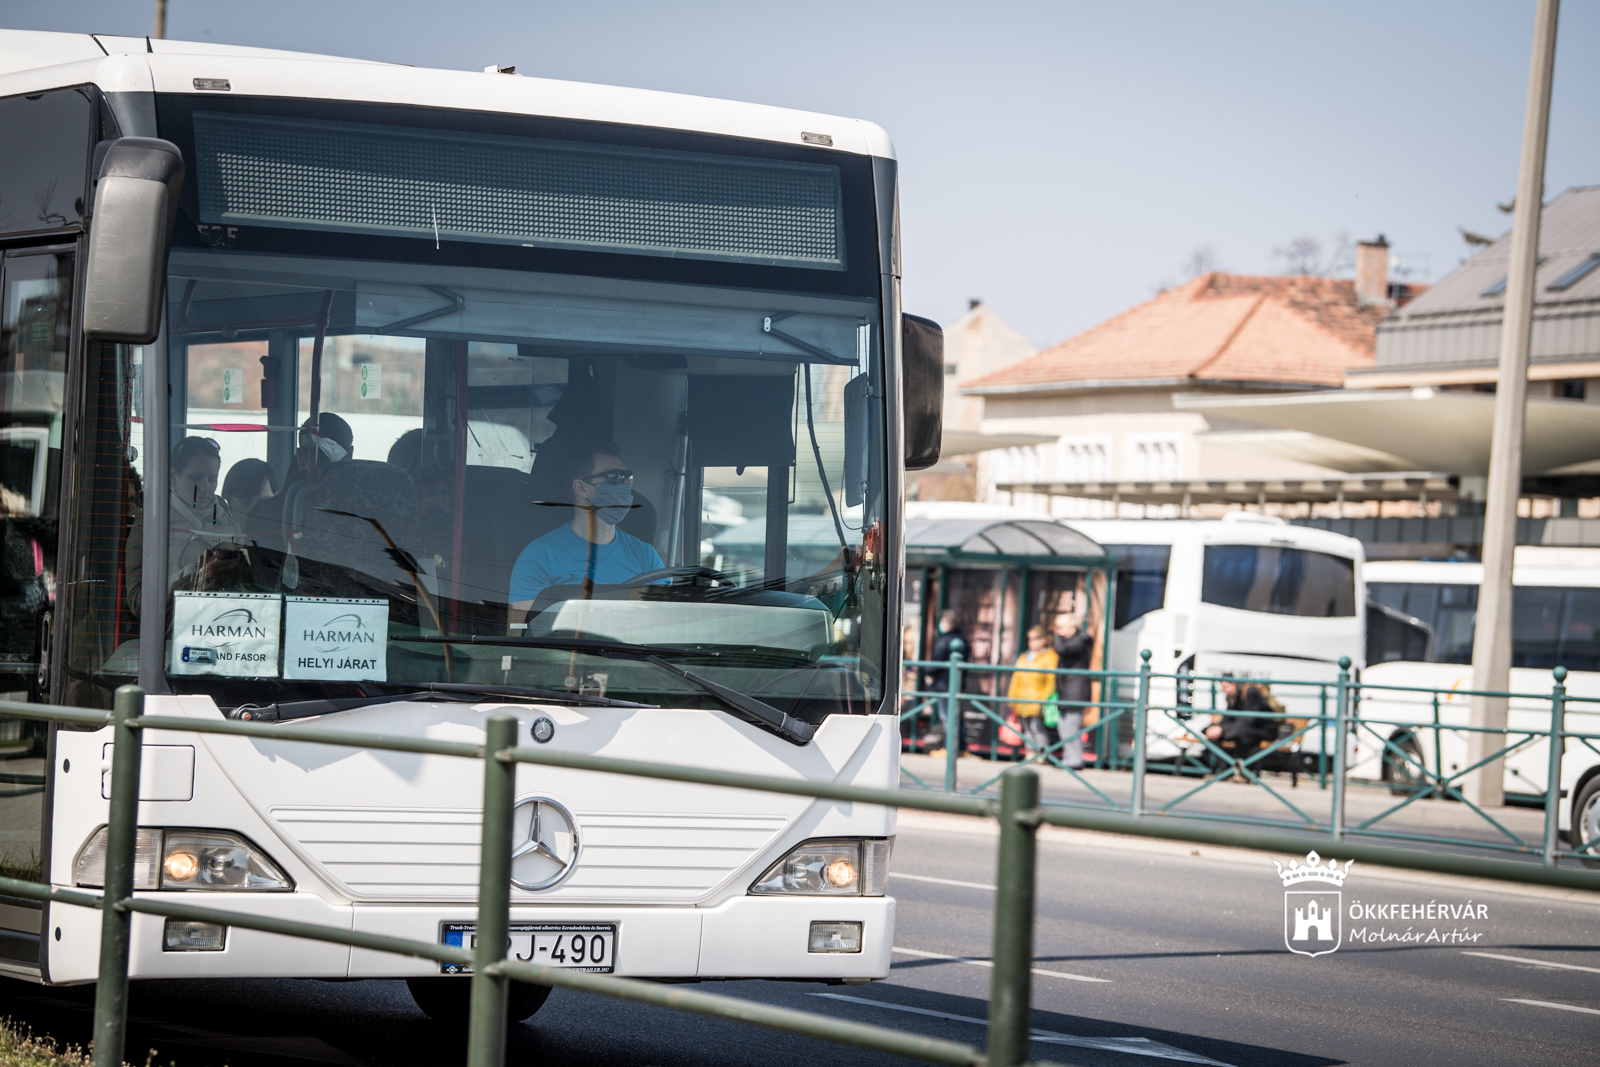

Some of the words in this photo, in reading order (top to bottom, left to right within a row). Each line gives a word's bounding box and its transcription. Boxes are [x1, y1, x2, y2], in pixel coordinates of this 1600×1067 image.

[192, 624, 266, 638] HARMAN
[303, 629, 375, 643] HARMAN
[215, 652, 233, 661] AND
[235, 653, 267, 662] FASOR
[298, 657, 333, 669] HELYI
[336, 656, 377, 670] JÁRAT
[470, 934, 605, 963] J-490
